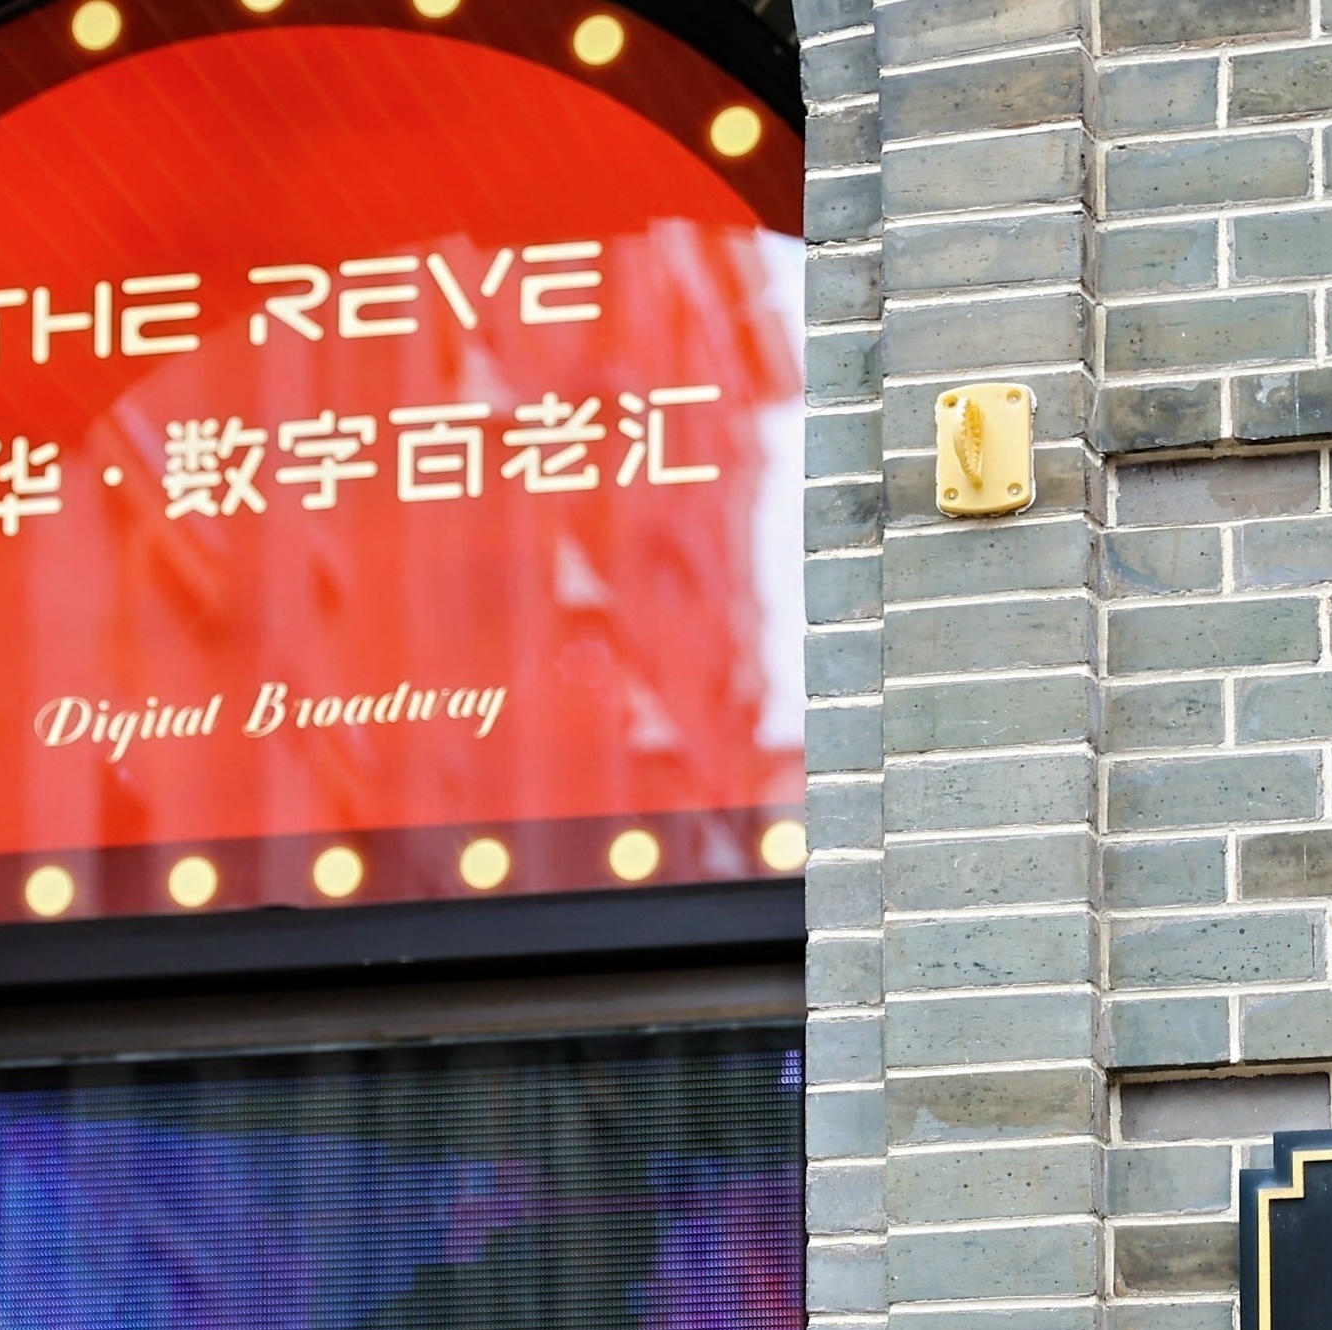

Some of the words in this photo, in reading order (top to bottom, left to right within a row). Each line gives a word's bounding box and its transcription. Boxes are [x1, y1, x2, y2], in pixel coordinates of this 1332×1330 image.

[248, 240, 602, 347] REVE
[34, 692, 224, 764] Digital
[243, 681, 507, 740] Broadway
